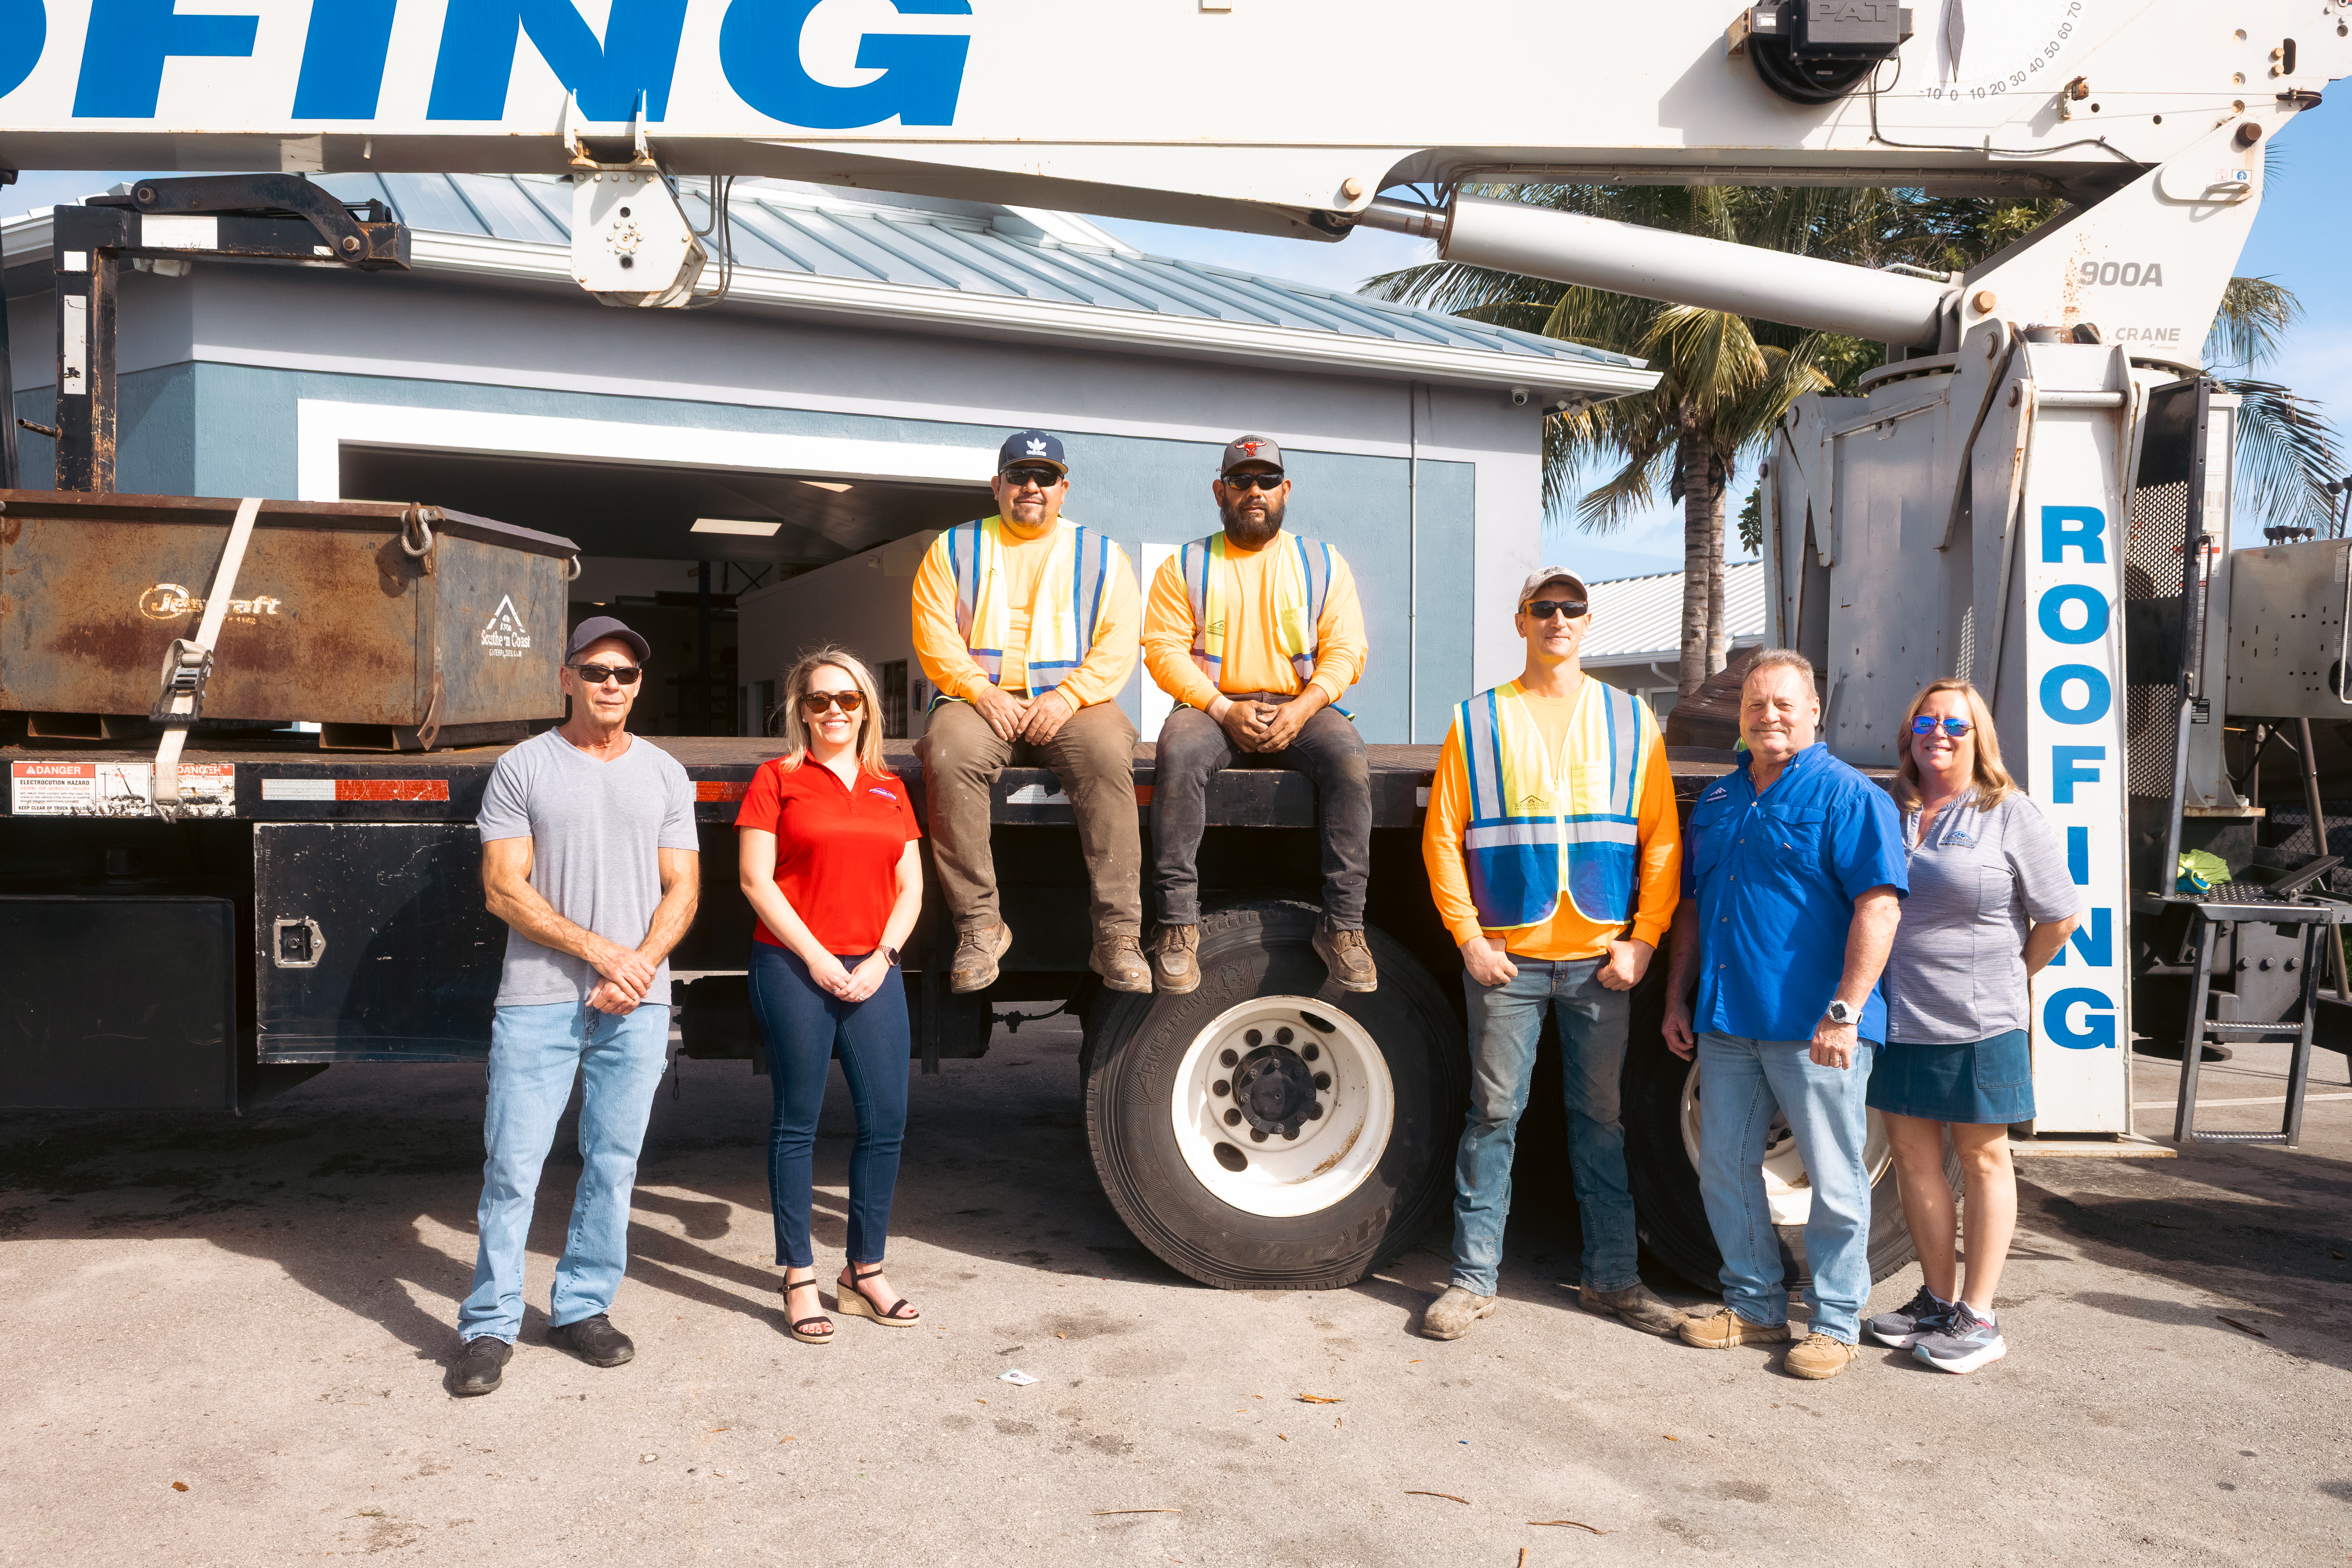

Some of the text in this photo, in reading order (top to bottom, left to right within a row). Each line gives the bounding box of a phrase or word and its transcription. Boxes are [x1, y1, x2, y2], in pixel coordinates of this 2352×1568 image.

[1809, 1, 1897, 22] PAT
[1950, 89, 1958, 101] 0
[1969, 87, 1986, 99] 10
[1989, 81, 2006, 95] 20
[2009, 71, 2026, 86] 30
[2030, 58, 2044, 74] 40
[2044, 41, 2060, 58] 50
[2058, 22, 2073, 39] 60
[2067, 2, 2081, 18] 70
[0, 0, 973, 129] FING
[2080, 261, 2163, 287] 900A
[2116, 327, 2181, 341] CRANE
[511, 632, 530, 648] Coast
[36, 766, 81, 775] DANGER
[178, 766, 221, 774] DANGER
[2038, 505, 2116, 1050] ROOFING
[1138, 982, 1215, 1103] ARMSTRONG
